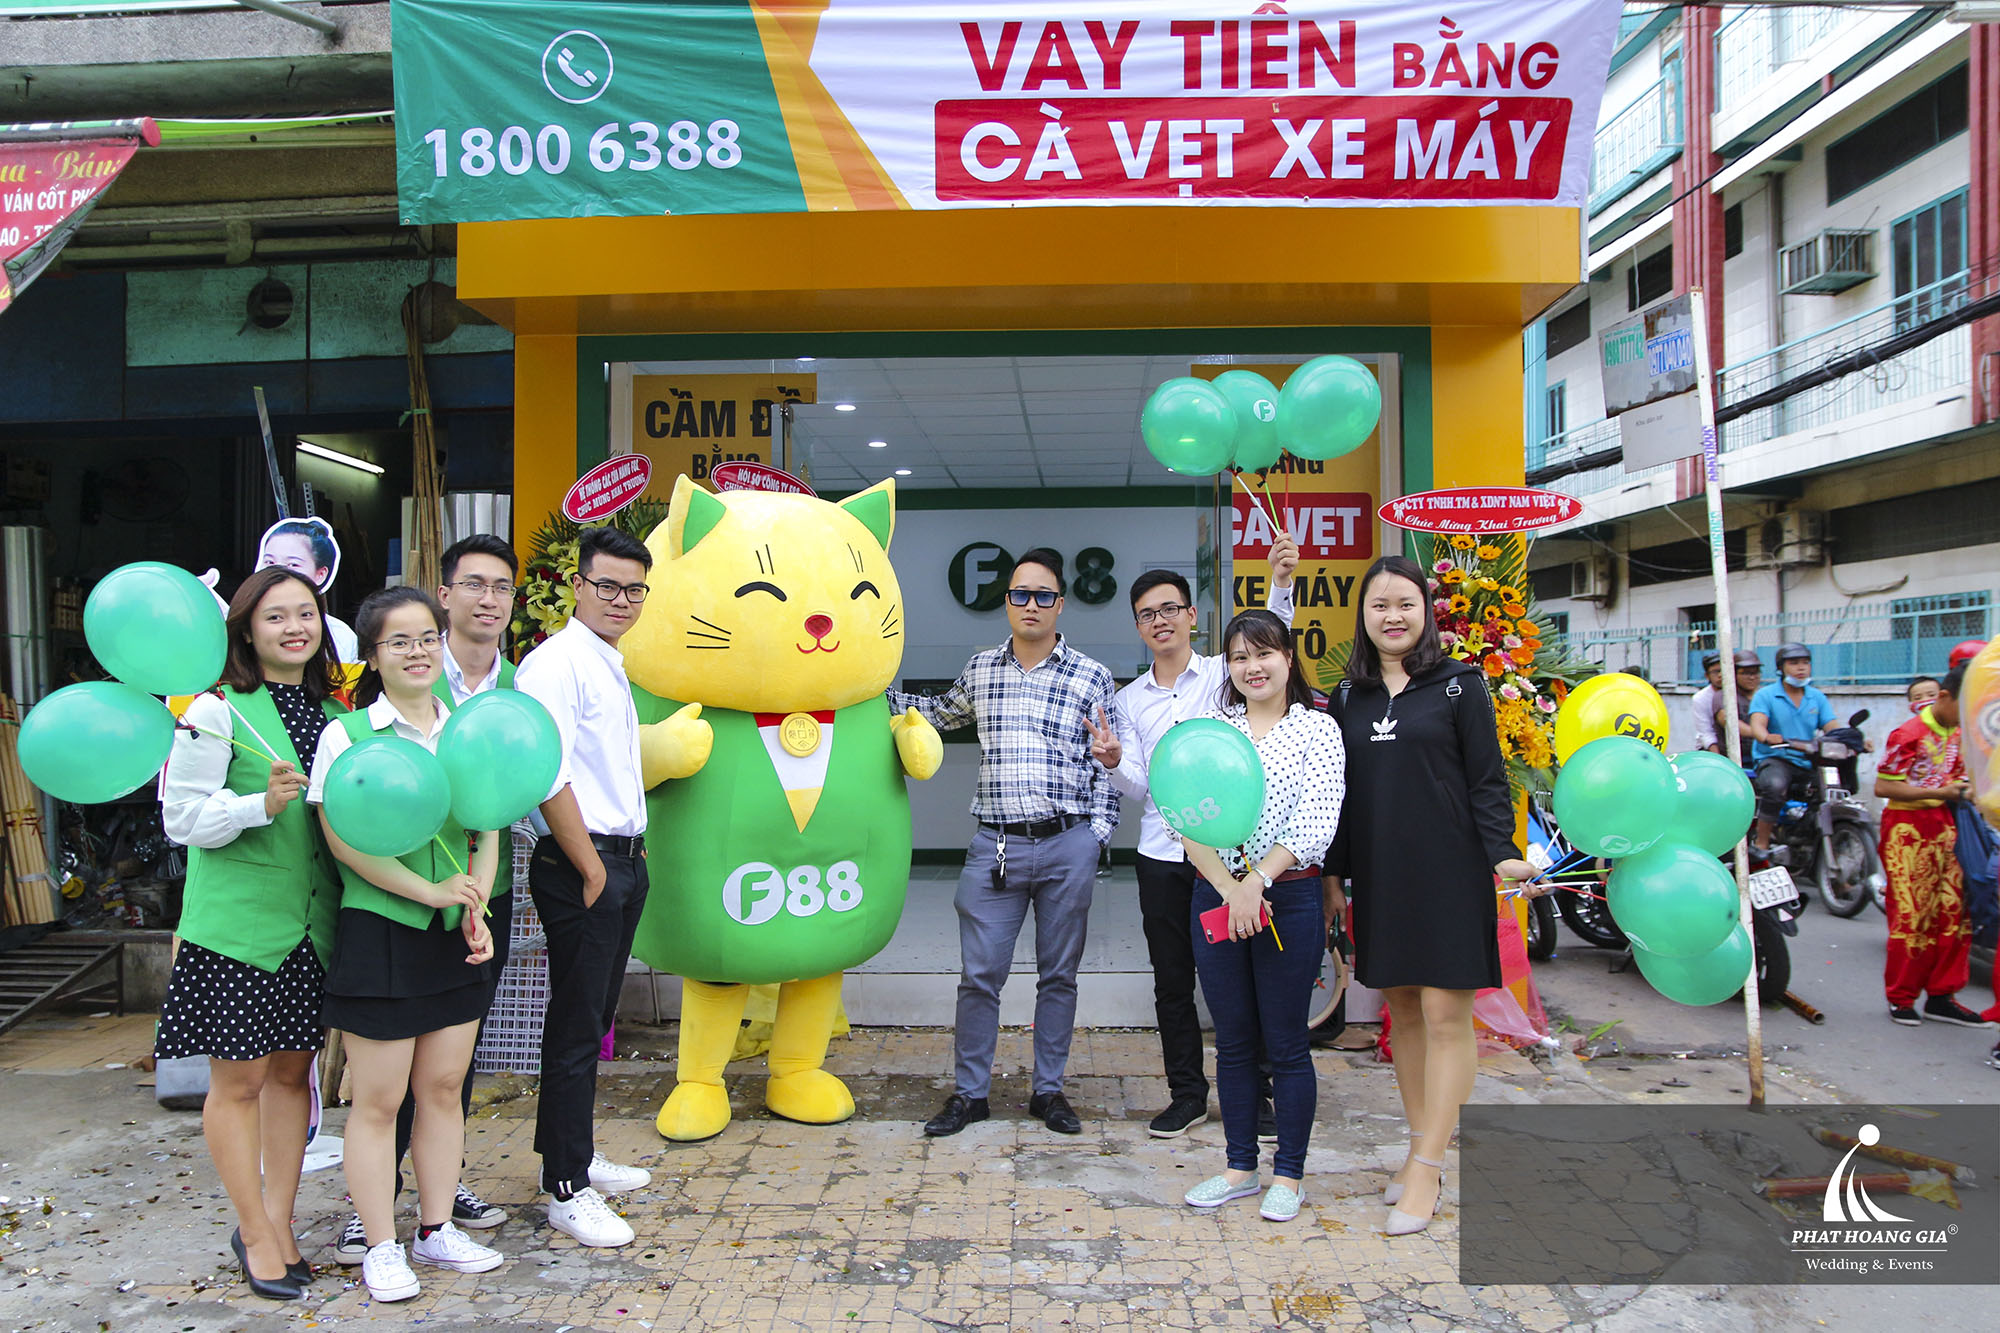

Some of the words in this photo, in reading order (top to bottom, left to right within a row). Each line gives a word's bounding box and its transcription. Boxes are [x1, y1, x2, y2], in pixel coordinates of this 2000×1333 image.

[959, 20, 1141, 91] VAY
[1170, 0, 1356, 90] TIỀN
[1392, 16, 1560, 90] BẰNG
[424, 124, 571, 177] 1800
[588, 119, 743, 172] 6388
[960, 101, 1083, 182] CÀ
[1107, 119, 1244, 197] VẸT
[1269, 118, 1366, 179] XE
[1394, 100, 1550, 180] MÁY
[4, 188, 34, 213] VÁN
[37, 183, 66, 211] CỐT
[70, 187, 97, 208] PH
[645, 388, 736, 438] CẦM
[750, 386, 805, 437] Đ
[1404, 496, 1425, 510] CTY
[1471, 496, 1479, 509] &
[1480, 495, 1507, 509] XDNT
[1508, 495, 1530, 509] NAM
[1532, 493, 1556, 509] VIỆT
[1405, 514, 1434, 528] Chúc
[1474, 519, 1509, 531] Khai
[1283, 507, 1361, 555] VẸT
[948, 541, 1117, 612] F8
[1370, 733, 1396, 741] adidas
[1159, 796, 1222, 829] F88
[722, 860, 863, 925] F88
